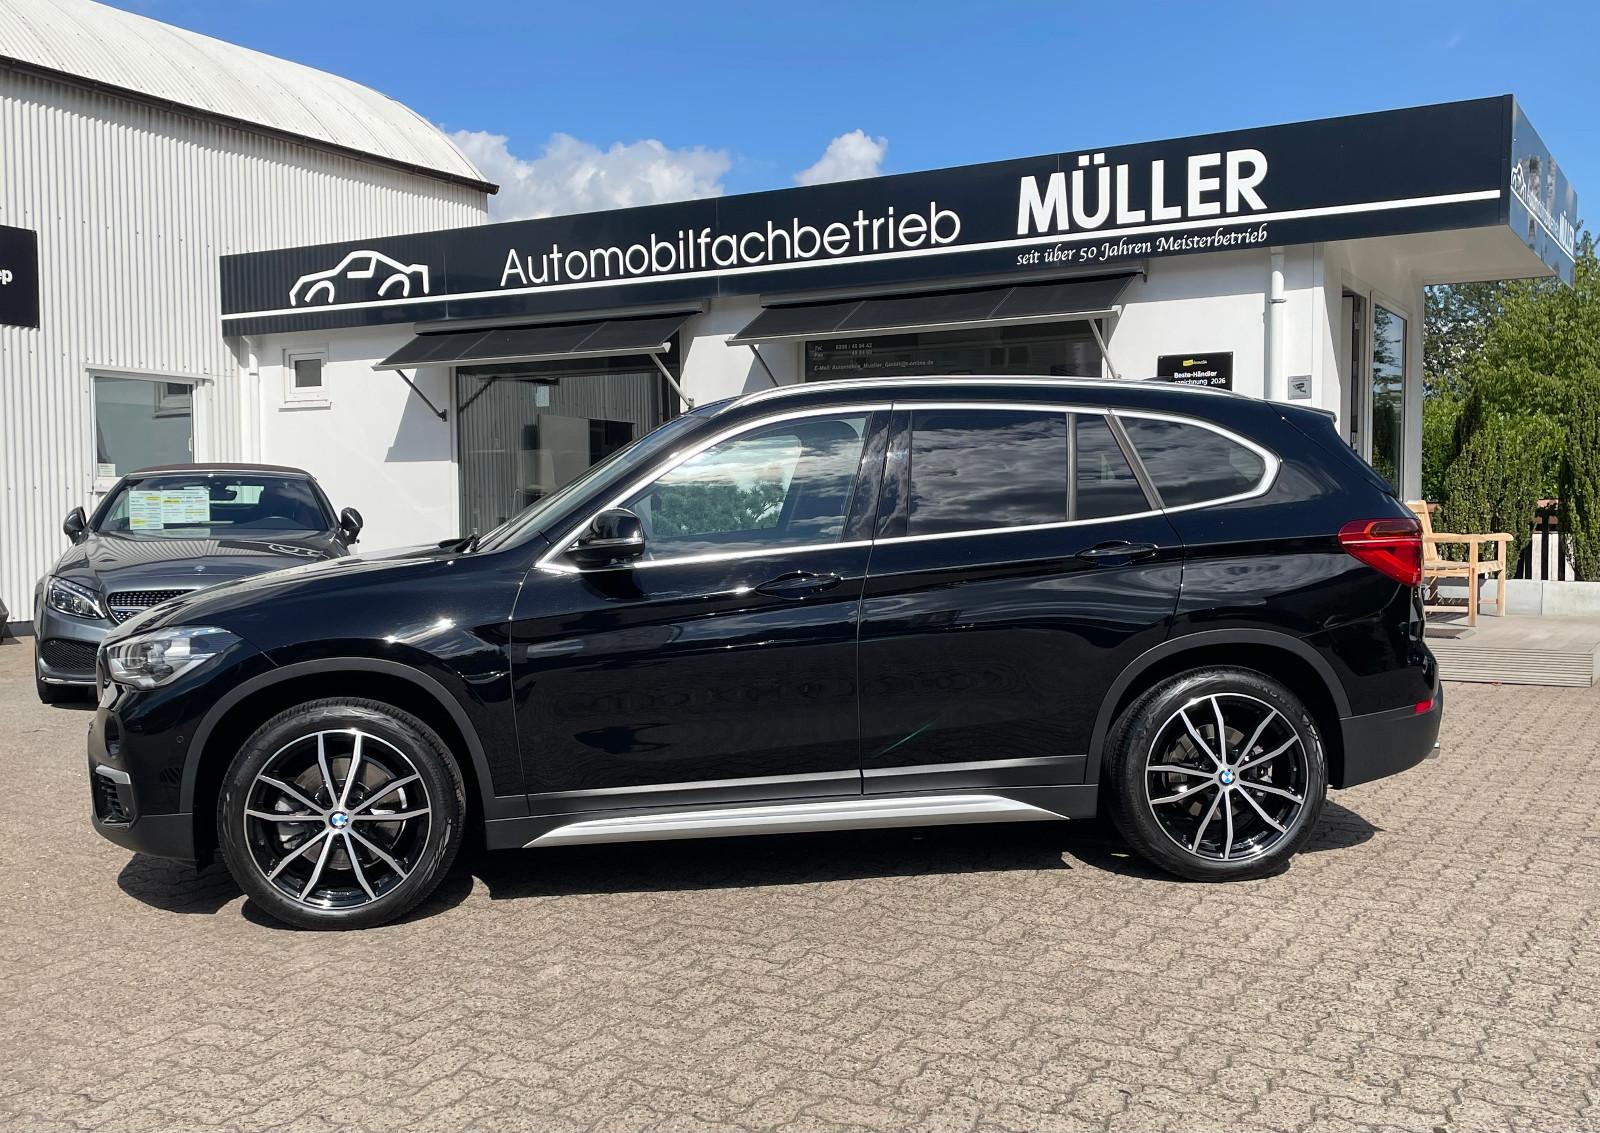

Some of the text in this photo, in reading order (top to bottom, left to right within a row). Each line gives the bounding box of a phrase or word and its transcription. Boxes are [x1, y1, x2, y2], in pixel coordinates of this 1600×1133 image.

[500, 149, 1268, 287] Automobilfachbetrieb MÜLLER
[1016, 222, 1268, 265] seit über 50 Jahren Meisterbetrieb
